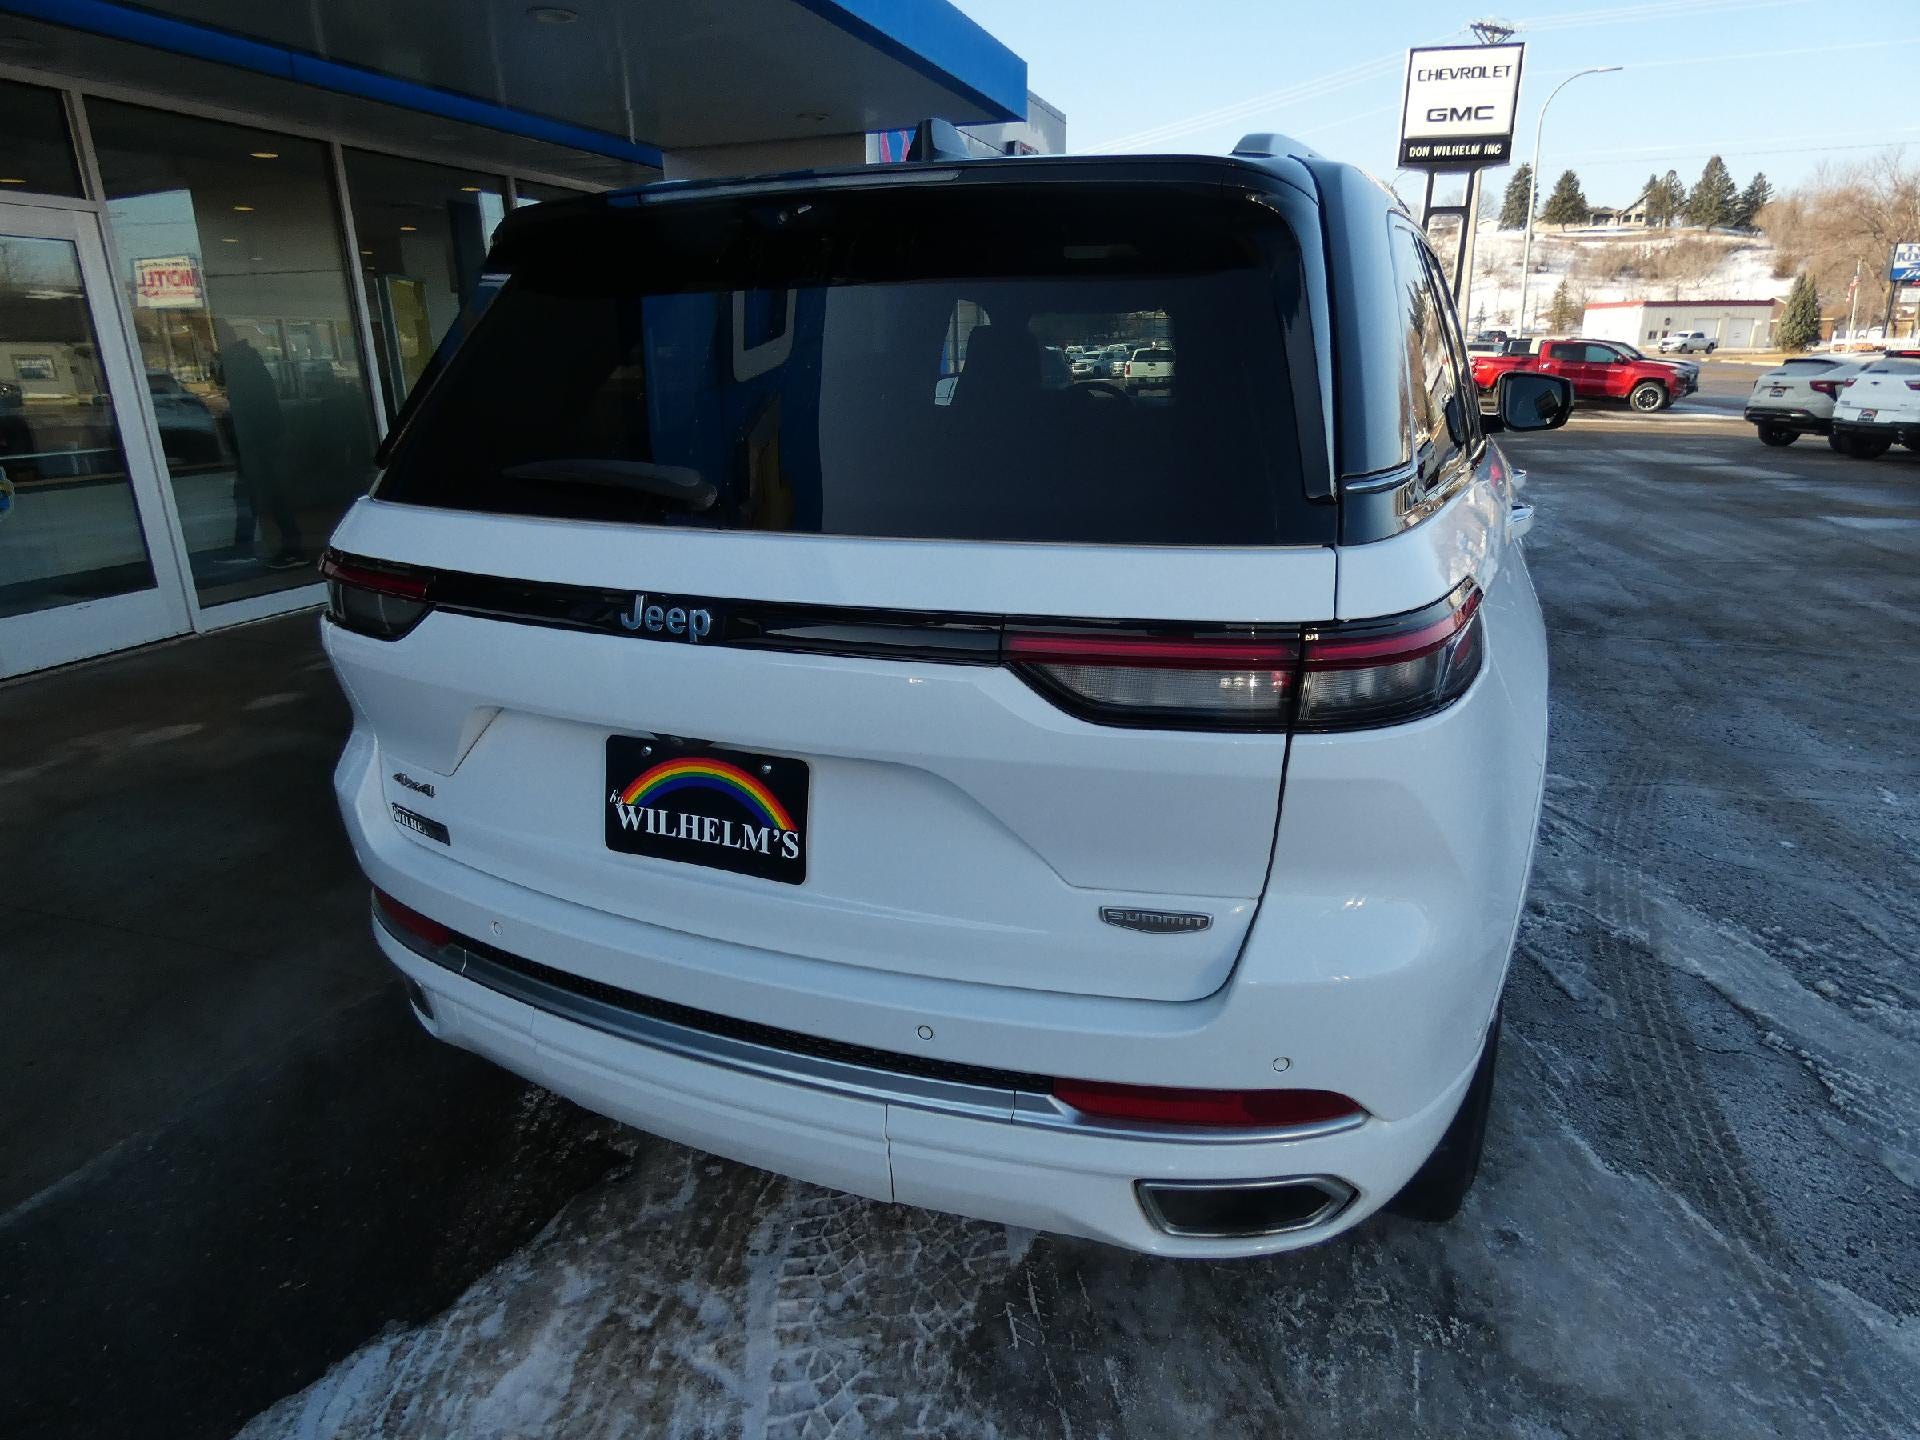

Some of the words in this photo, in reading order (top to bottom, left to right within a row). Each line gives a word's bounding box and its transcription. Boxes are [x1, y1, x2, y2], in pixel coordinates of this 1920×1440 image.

[1417, 65, 1513, 82] CHEVROLET
[1426, 105, 1495, 122] GMC
[1409, 145, 1430, 158] DON
[1433, 144, 1480, 156] WILHELM
[1484, 143, 1502, 155] INC
[620, 594, 711, 643] Jeep
[615, 804, 800, 859] WILHELM'S
